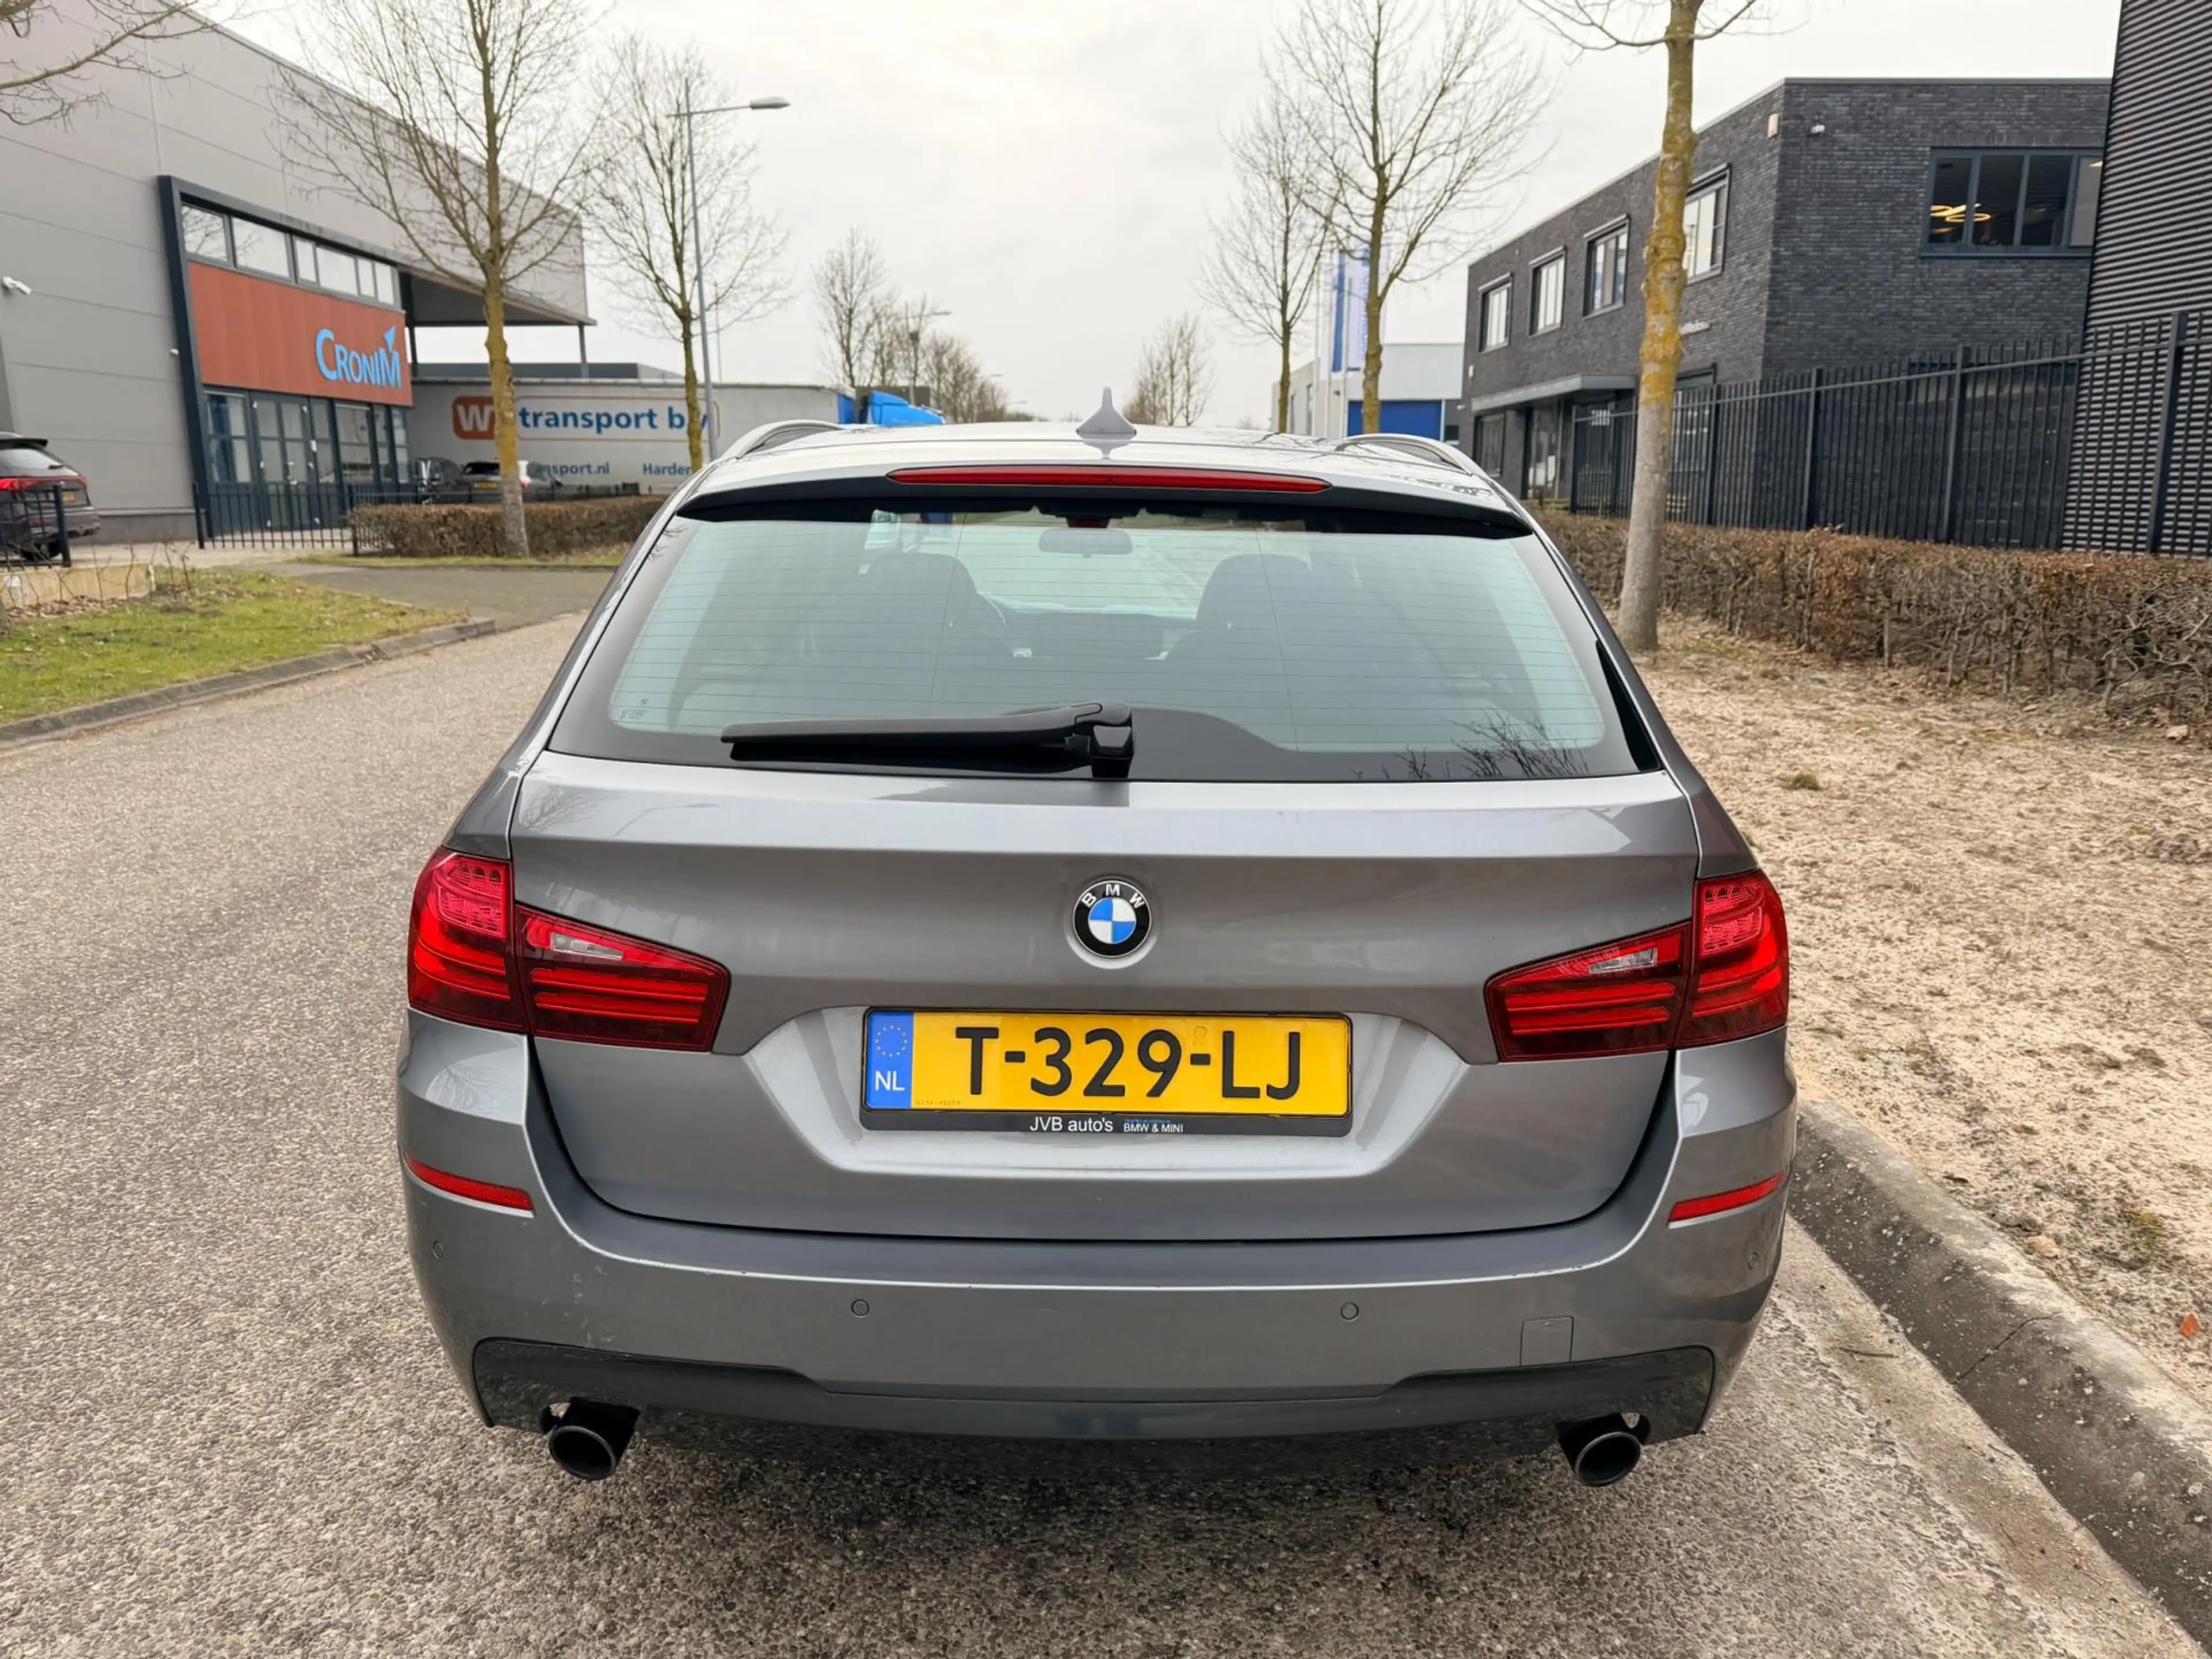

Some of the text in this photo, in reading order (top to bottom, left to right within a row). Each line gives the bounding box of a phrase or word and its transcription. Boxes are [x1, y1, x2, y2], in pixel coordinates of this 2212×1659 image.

[518, 407, 658, 434] transport
[1081, 884, 1145, 908] BMW
[955, 1027, 1301, 1100] T-329-LJ
[875, 1071, 905, 1092] NL
[1030, 1117, 1062, 1131] JVB
[1068, 1118, 1113, 1132] auto's
[1124, 1124, 1148, 1132] BMW
[1152, 1124, 1159, 1133] &
[1161, 1124, 1183, 1133] MINI
